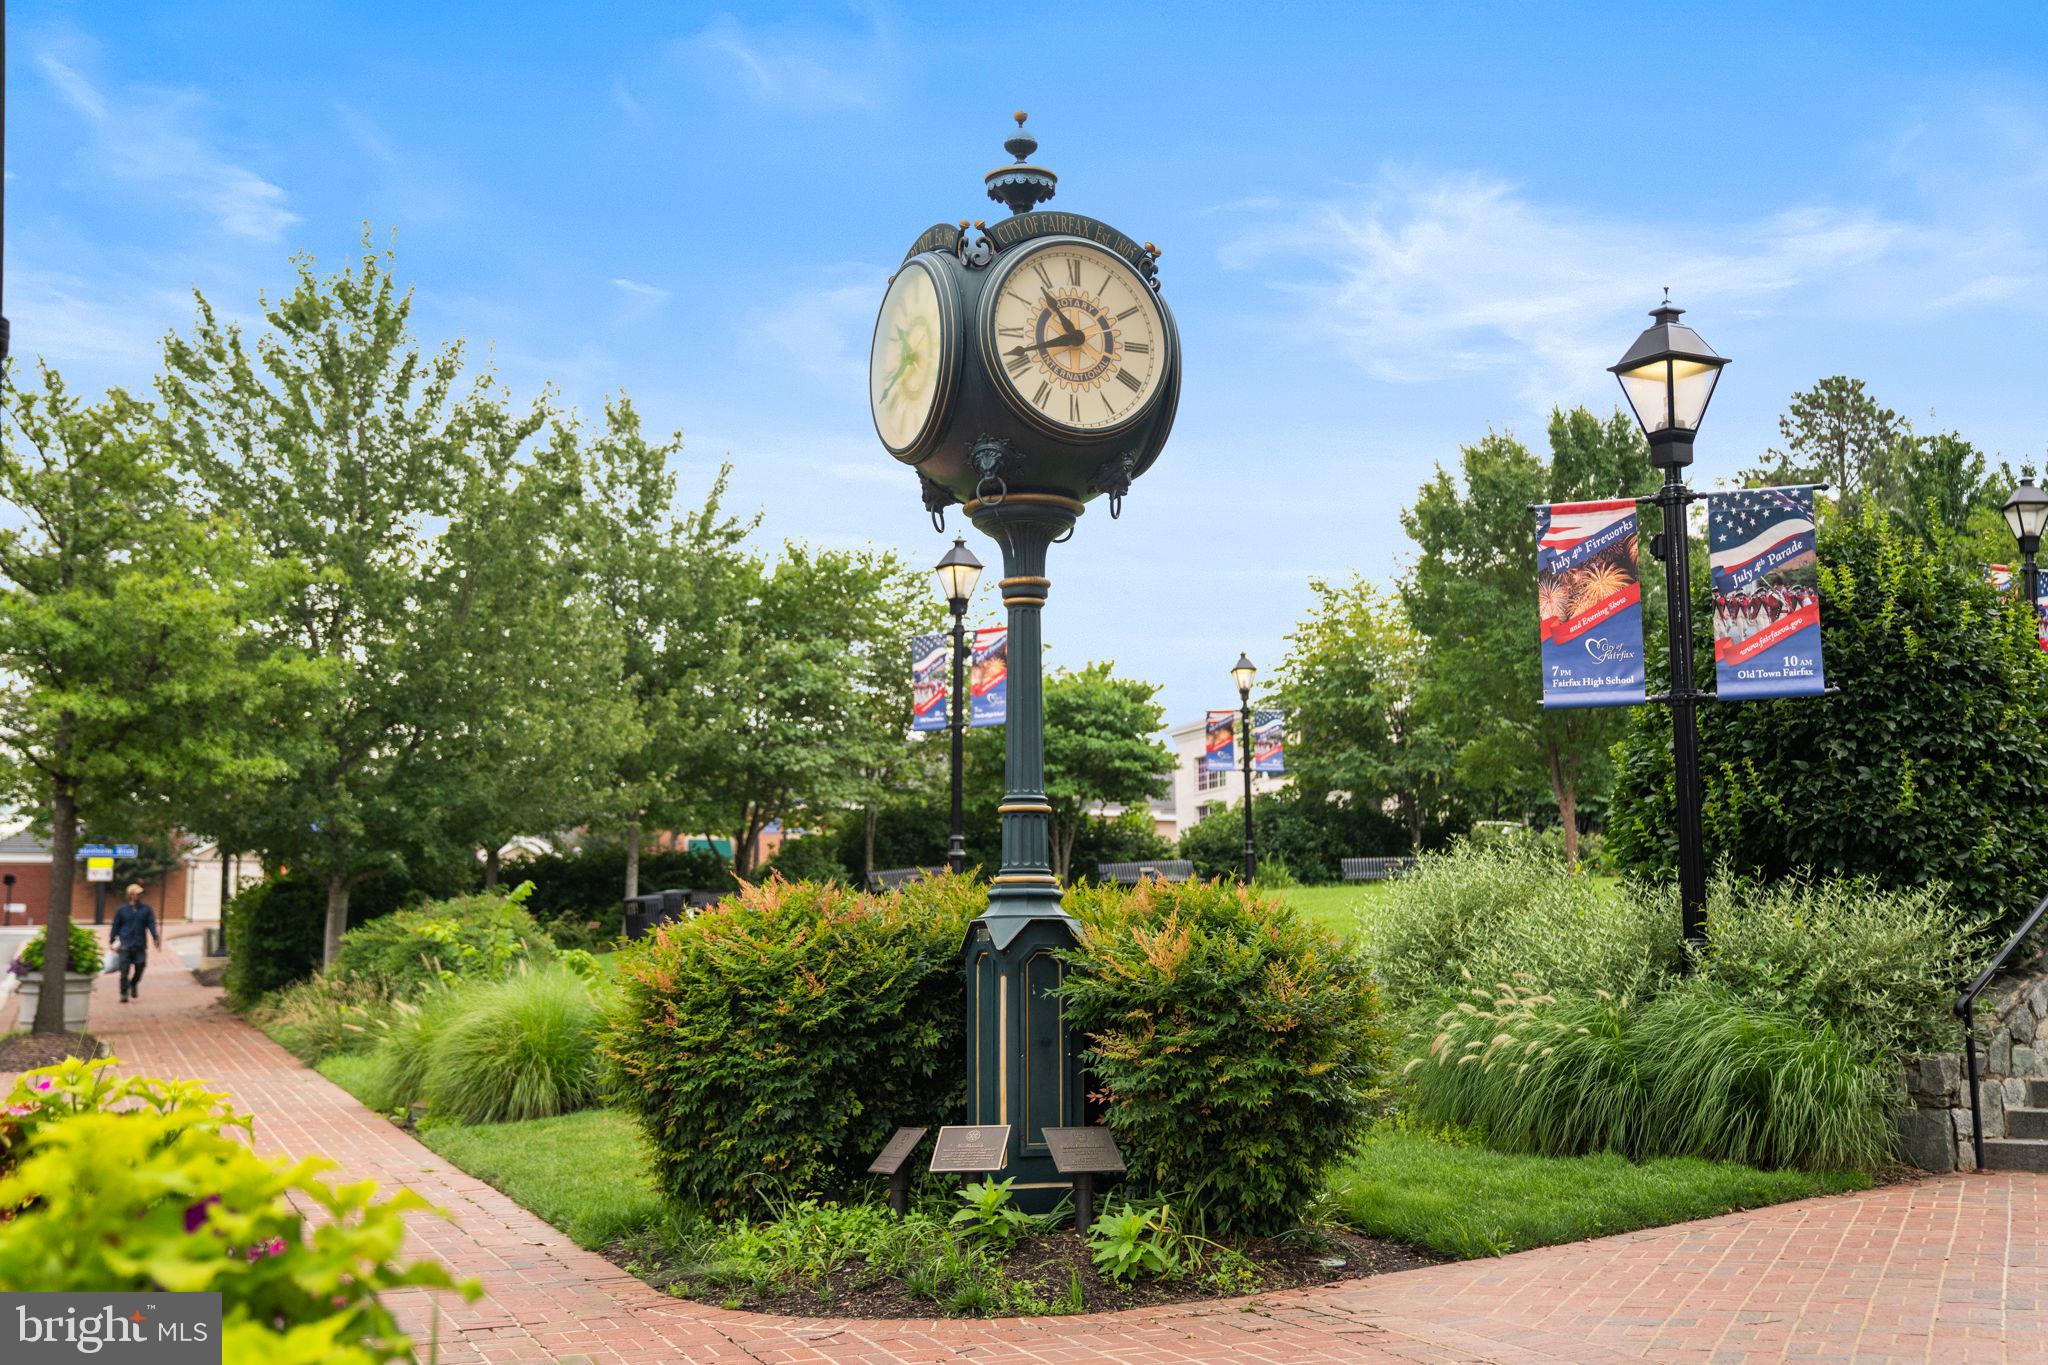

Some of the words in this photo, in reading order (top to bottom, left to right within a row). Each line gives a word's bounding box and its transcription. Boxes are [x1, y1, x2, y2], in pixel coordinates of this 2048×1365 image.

[997, 219, 1025, 245] CITY
[1024, 216, 1039, 234] OF
[1041, 214, 1092, 237] FAIRFAX
[1042, 353, 1111, 382] INTERNATIONAL
[1551, 556, 1572, 575] July
[1571, 546, 1583, 560] 4th
[1584, 519, 1633, 553] Fireworks
[1731, 569, 1753, 589] July
[1753, 558, 1766, 573] 4th
[1767, 541, 1803, 566] Parade
[1569, 620, 1582, 633] and
[1582, 606, 1609, 628] Evening
[1608, 597, 1628, 612] Show
[1739, 617, 1803, 656] www.fairfaxva.gov
[1552, 665, 1559, 677] 7
[1560, 669, 1571, 677] PM
[1737, 670, 1756, 680] Old
[1756, 669, 1781, 679] Town
[1783, 667, 1814, 677] Fairfax
[1783, 655, 1799, 667] 10
[1799, 659, 1813, 667] AM
[1552, 678, 1582, 688] Fairfax
[1582, 677, 1604, 688] High
[1605, 675, 1635, 686] School
